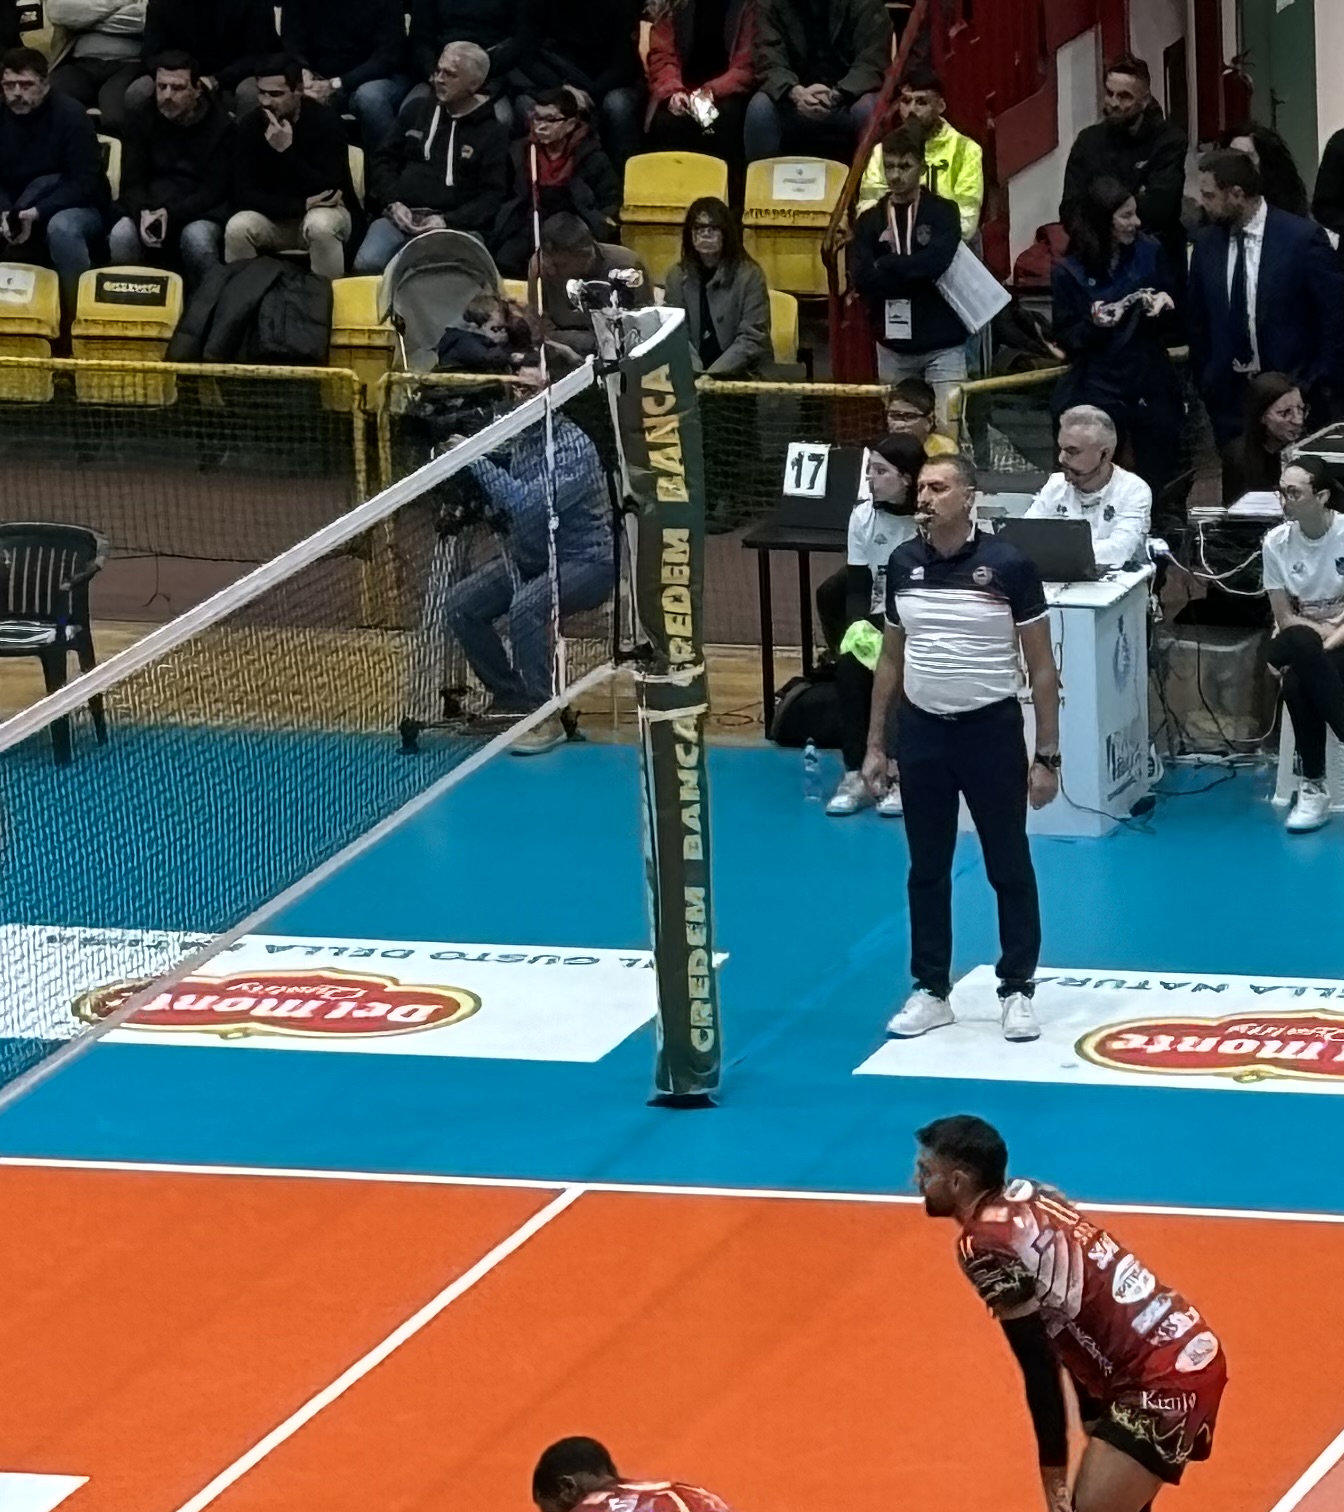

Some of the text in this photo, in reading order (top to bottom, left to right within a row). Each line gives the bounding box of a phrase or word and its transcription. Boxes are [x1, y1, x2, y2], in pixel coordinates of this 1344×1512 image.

[790, 450, 826, 490] 17
[641, 363, 697, 687] CREDEM BANCA
[672, 712, 716, 1052] CREDEM BANCA
[264, 943, 416, 960] DELLA
[429, 950, 601, 966] GUSTO
[1032, 976, 1230, 993] NATURA
[322, 1000, 445, 1024] Del
